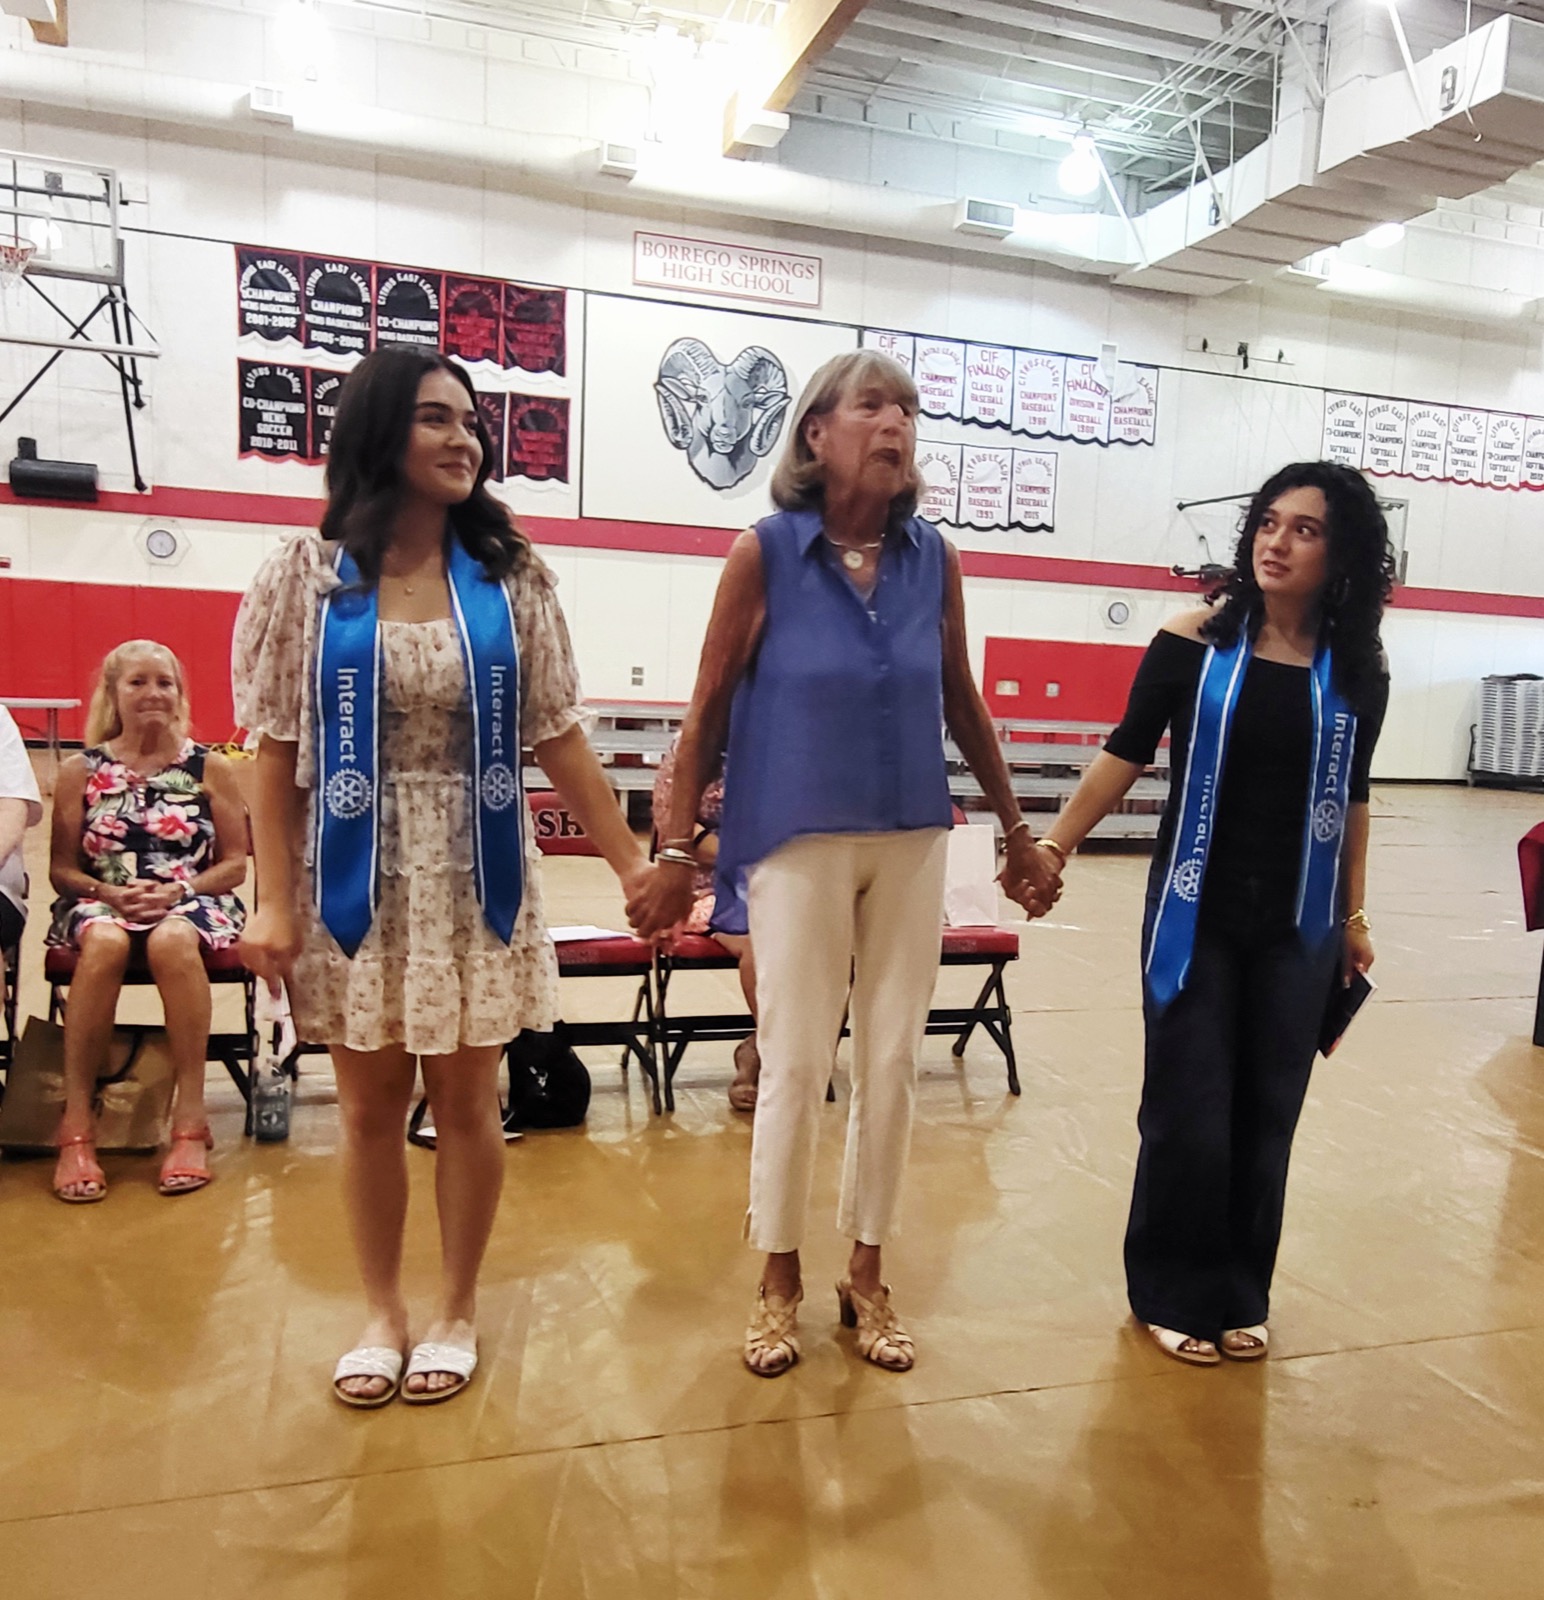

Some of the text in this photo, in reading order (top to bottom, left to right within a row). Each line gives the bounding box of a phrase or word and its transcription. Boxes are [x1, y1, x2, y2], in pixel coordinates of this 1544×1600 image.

[642, 240, 815, 280] BORREGO SPRINGS
[324, 263, 349, 275] EAST
[350, 272, 371, 304] LEAGUE
[662, 261, 795, 295] HIGH SCHOOL
[377, 277, 397, 306] CITRUS
[396, 272, 420, 283] EAST
[418, 279, 439, 310] LEAGUE
[311, 299, 364, 317] CHAMPIONS
[245, 312, 297, 329] 2001-2002
[377, 315, 439, 332] CO-CHAMPIONS
[879, 335, 898, 349] CIF
[980, 349, 999, 364] CIF
[245, 366, 302, 394] CITRUS LEAGUE
[967, 363, 1012, 381] FINALIST
[1018, 358, 1060, 388] CITRUS LEAGUE
[314, 377, 340, 400] CITRUS
[971, 381, 993, 393] CLASS
[970, 393, 1004, 405] BASEBALL
[1020, 390, 1058, 402] CHAMPIONS
[1069, 398, 1095, 409] DIVISION
[242, 396, 306, 414] CO-CHAMPIONS
[1021, 402, 1056, 413] BASEBALL
[1113, 406, 1153, 417] CHAMPIONS
[1327, 399, 1347, 415] CITRUS
[1368, 404, 1389, 418] CITRUS
[1069, 413, 1102, 425] BASEBALL
[1113, 417, 1152, 428] BASEBALL
[256, 422, 293, 437] SOCCER
[250, 435, 298, 451] 2010-2011
[935, 452, 958, 482] LEAGUE
[966, 453, 987, 480] CITRUS
[967, 484, 1003, 495] CHAMPIONS
[1015, 484, 1051, 495] CHAMPIONS
[967, 497, 1003, 508] BASEBALL
[1015, 496, 1048, 508] BASEBALL
[337, 667, 359, 763] Interact
[490, 665, 507, 757] Interact
[1325, 712, 1349, 795] Interact
